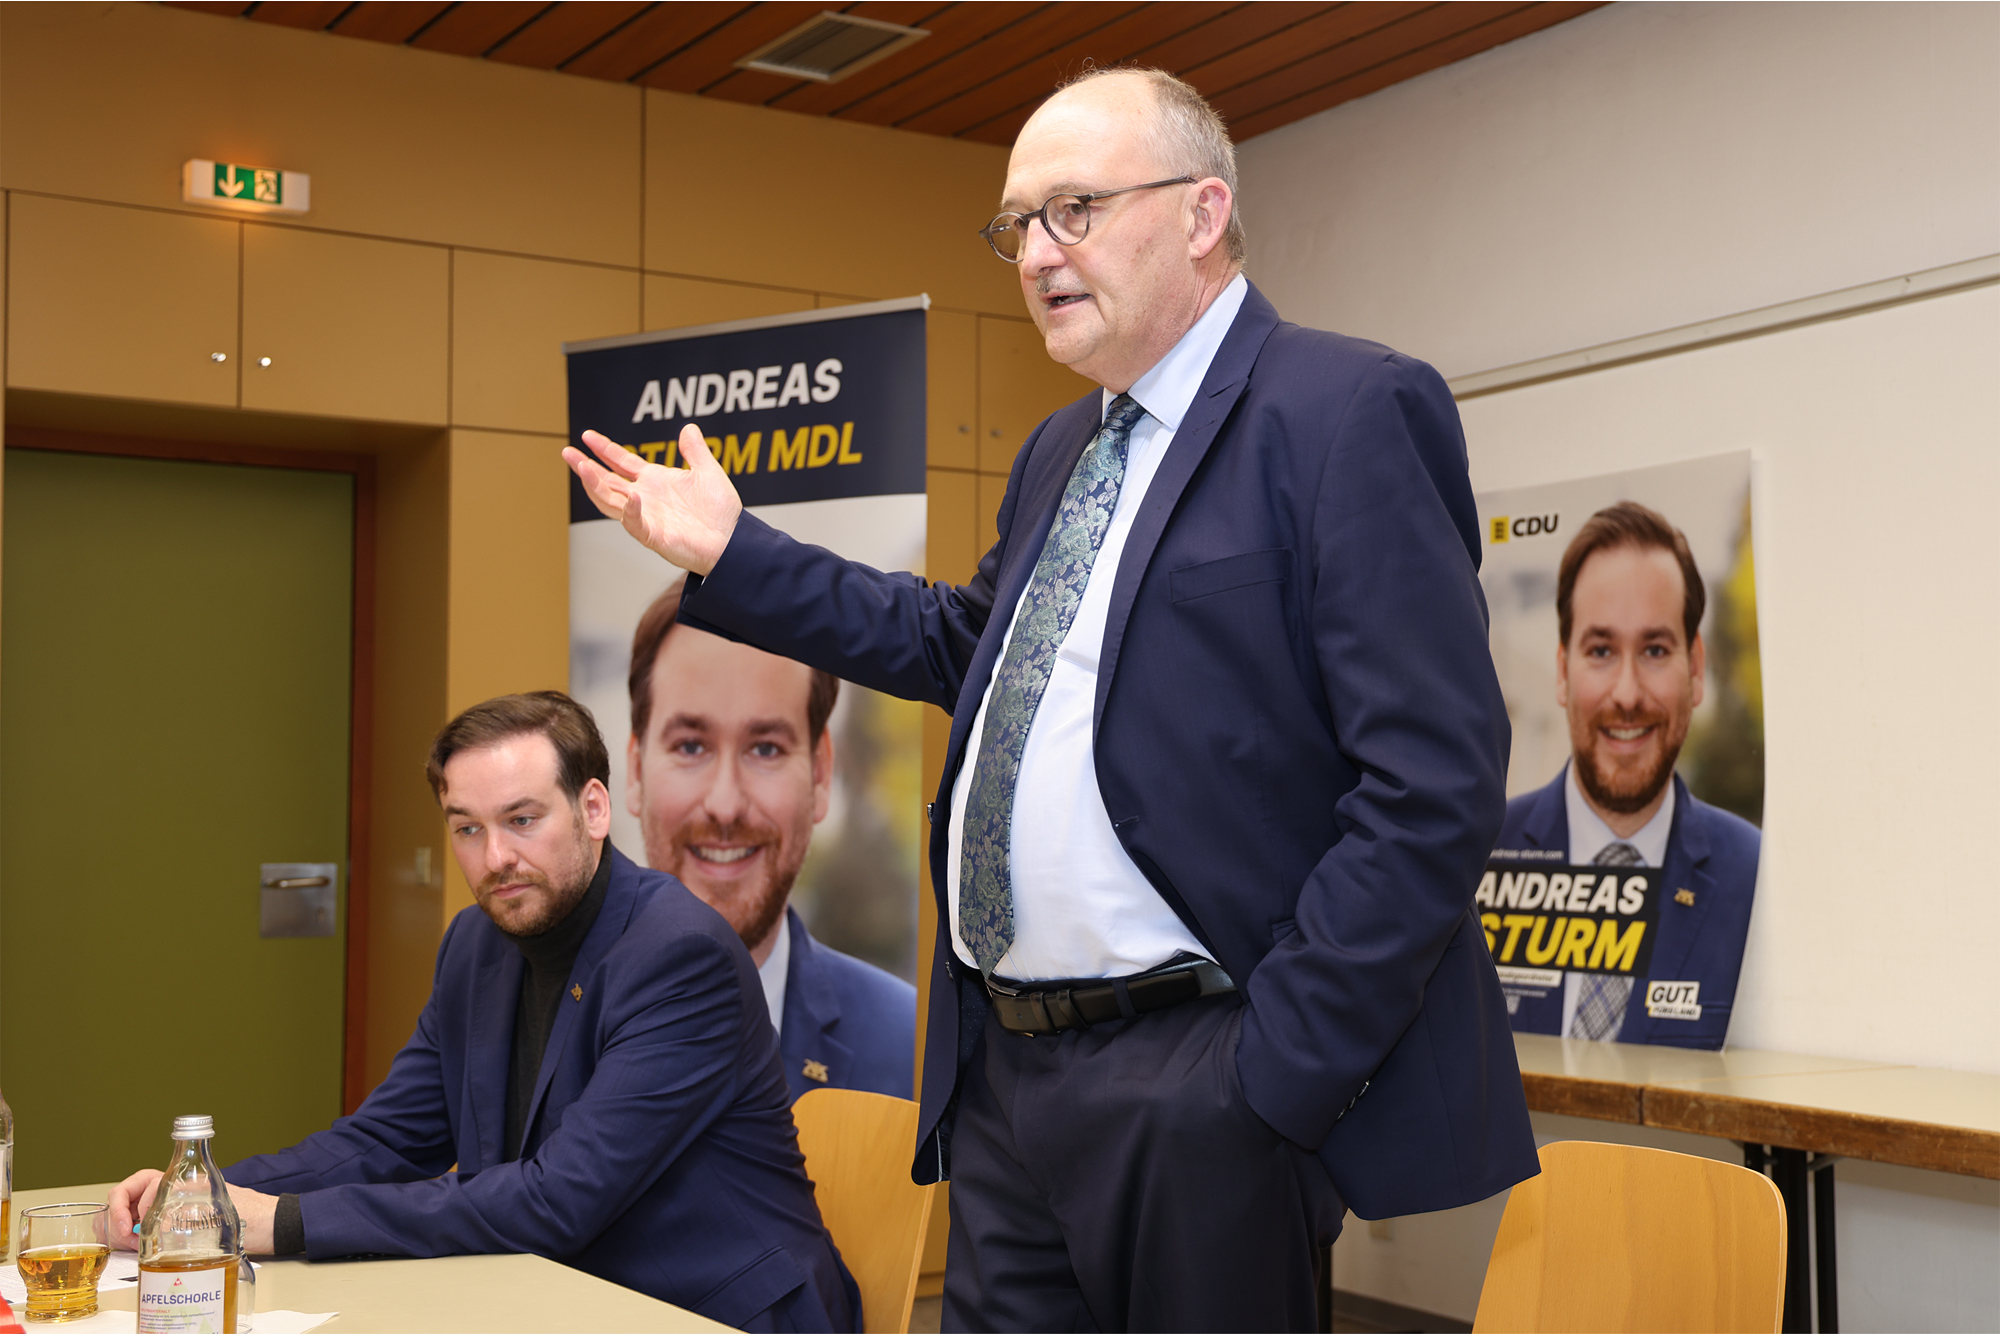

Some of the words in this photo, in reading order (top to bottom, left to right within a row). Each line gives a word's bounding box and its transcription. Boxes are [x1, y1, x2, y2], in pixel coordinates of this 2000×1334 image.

[632, 358, 843, 424] ANDREAS
[767, 421, 863, 472] MDL
[1512, 513, 1559, 537] CDU
[1475, 871, 1648, 915] ANDREAS
[1652, 986, 1694, 1004] GUT.
[142, 1290, 221, 1305] APFELSCHORLE
